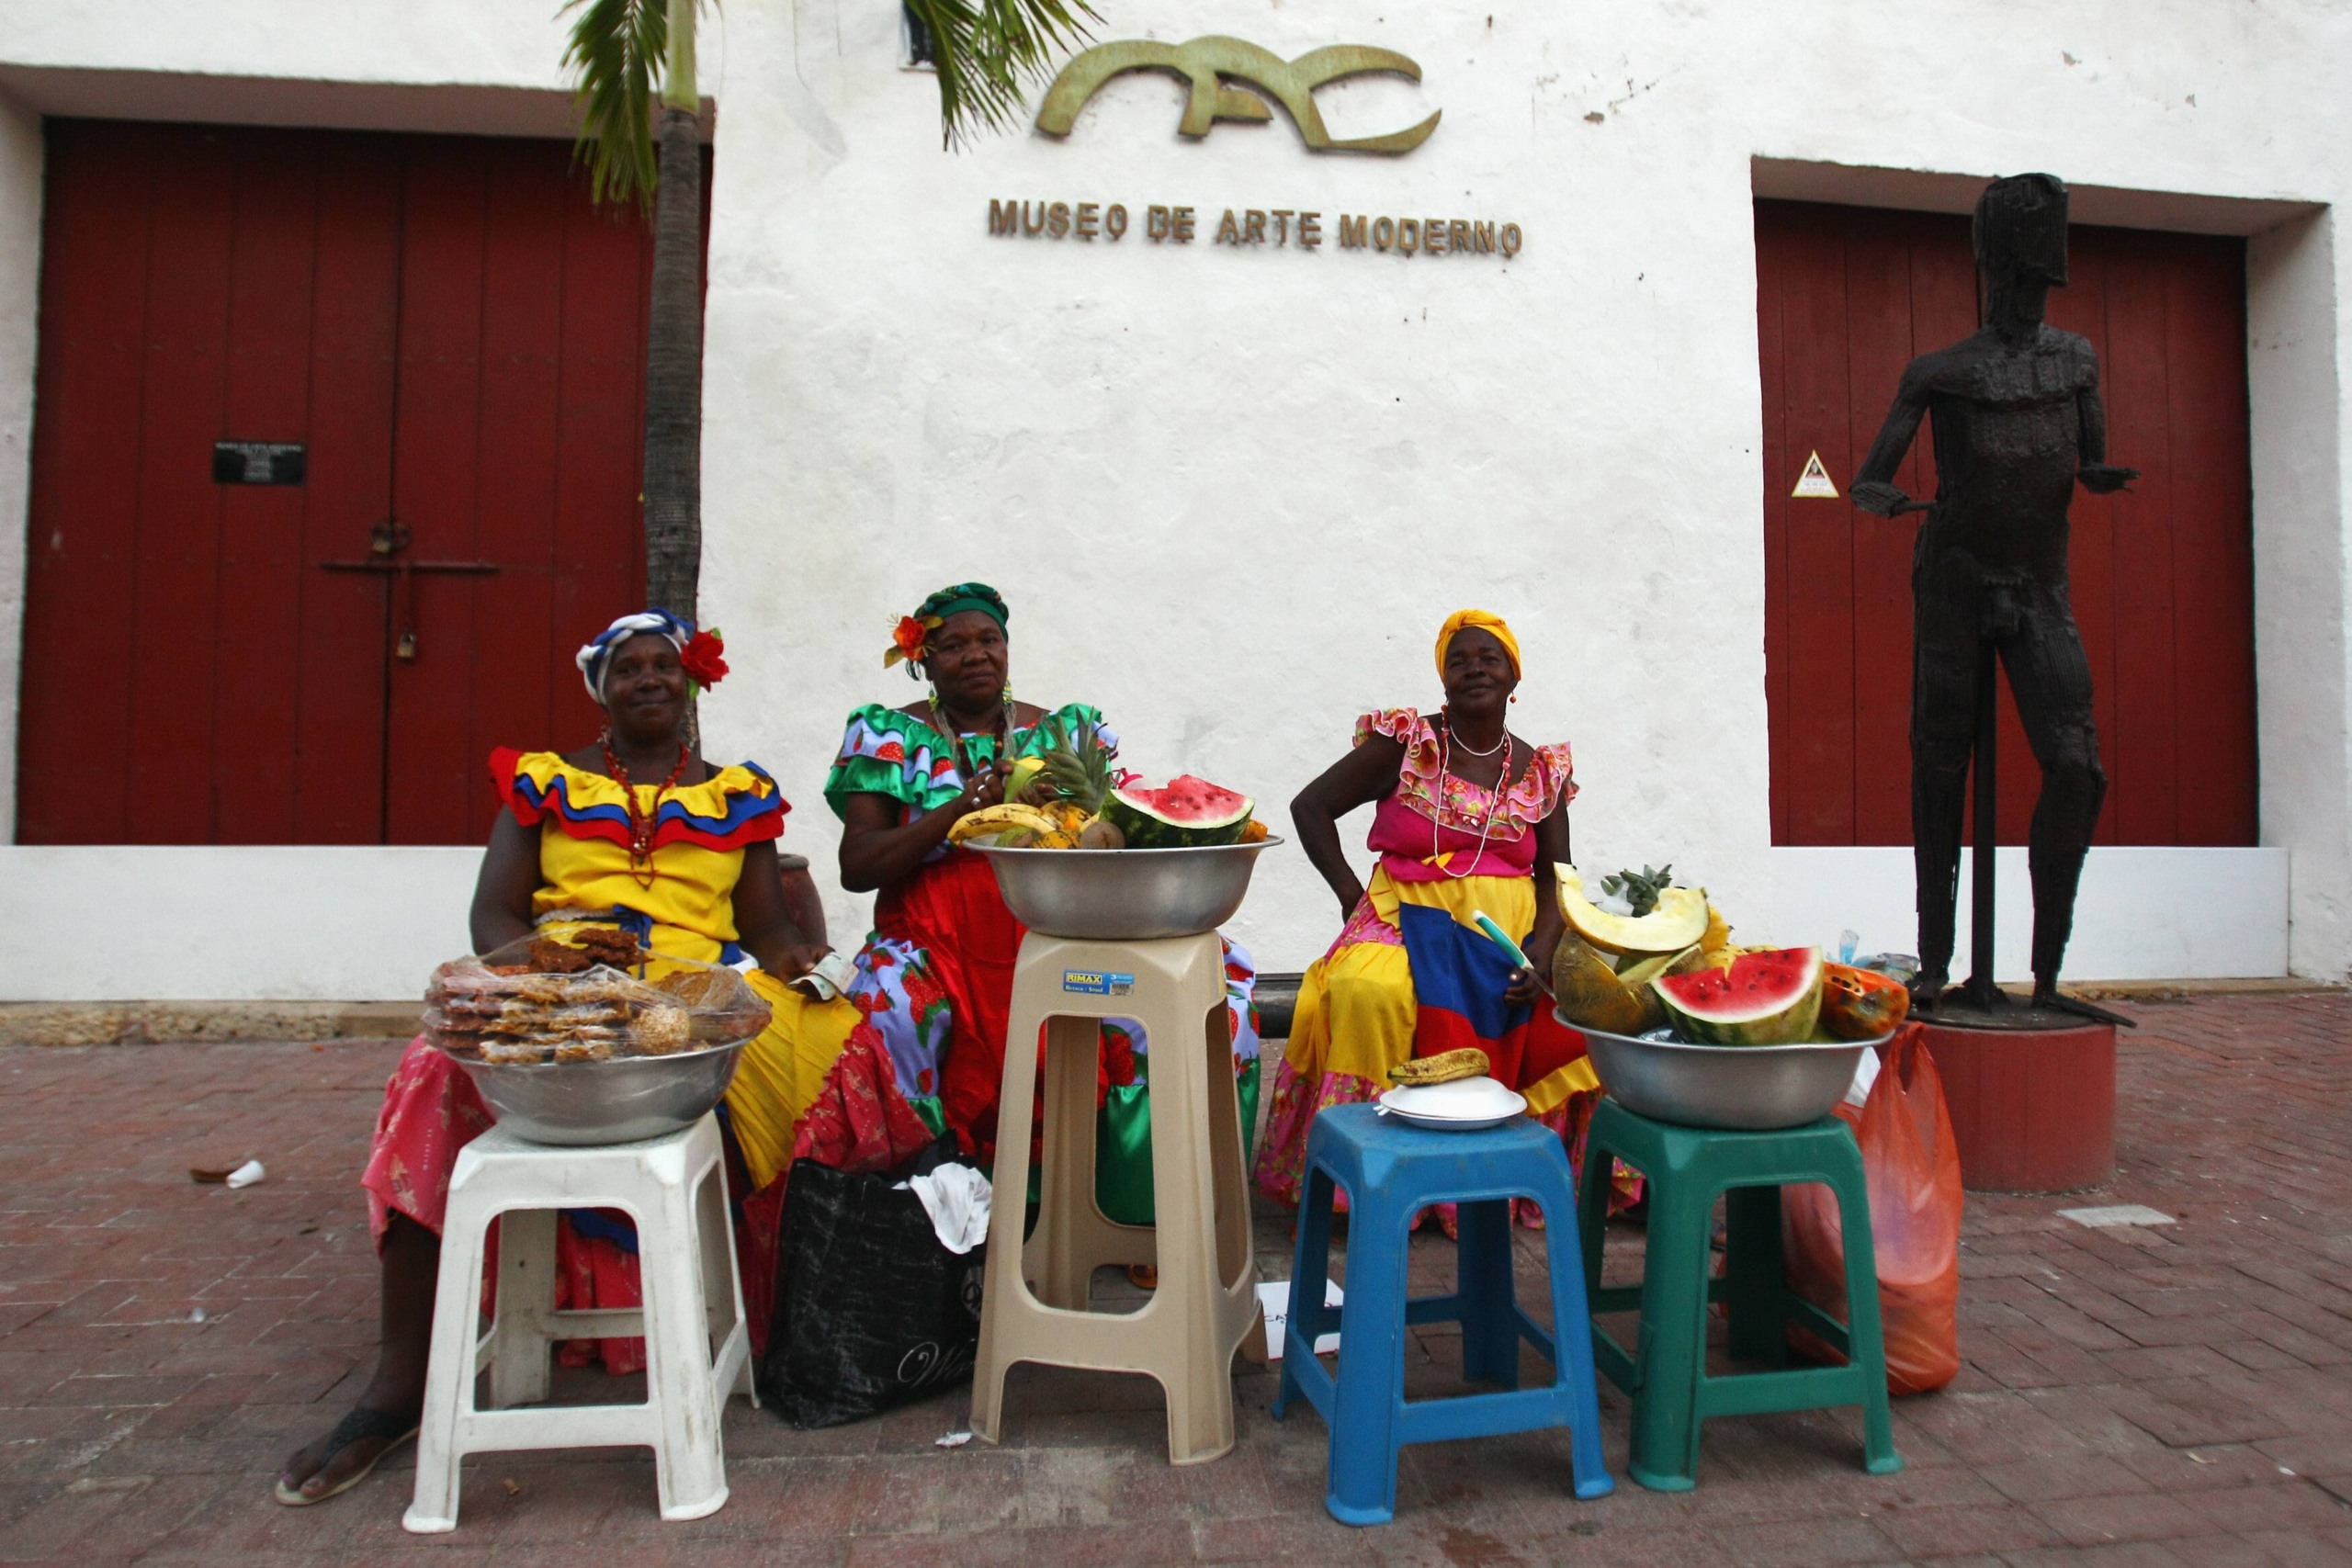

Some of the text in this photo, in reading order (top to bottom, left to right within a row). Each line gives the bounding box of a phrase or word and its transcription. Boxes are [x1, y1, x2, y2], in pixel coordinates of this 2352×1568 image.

[989, 199, 1522, 254] MUSEO DE ARTE MODERNO
[1067, 975, 1101, 983] RIMAX
